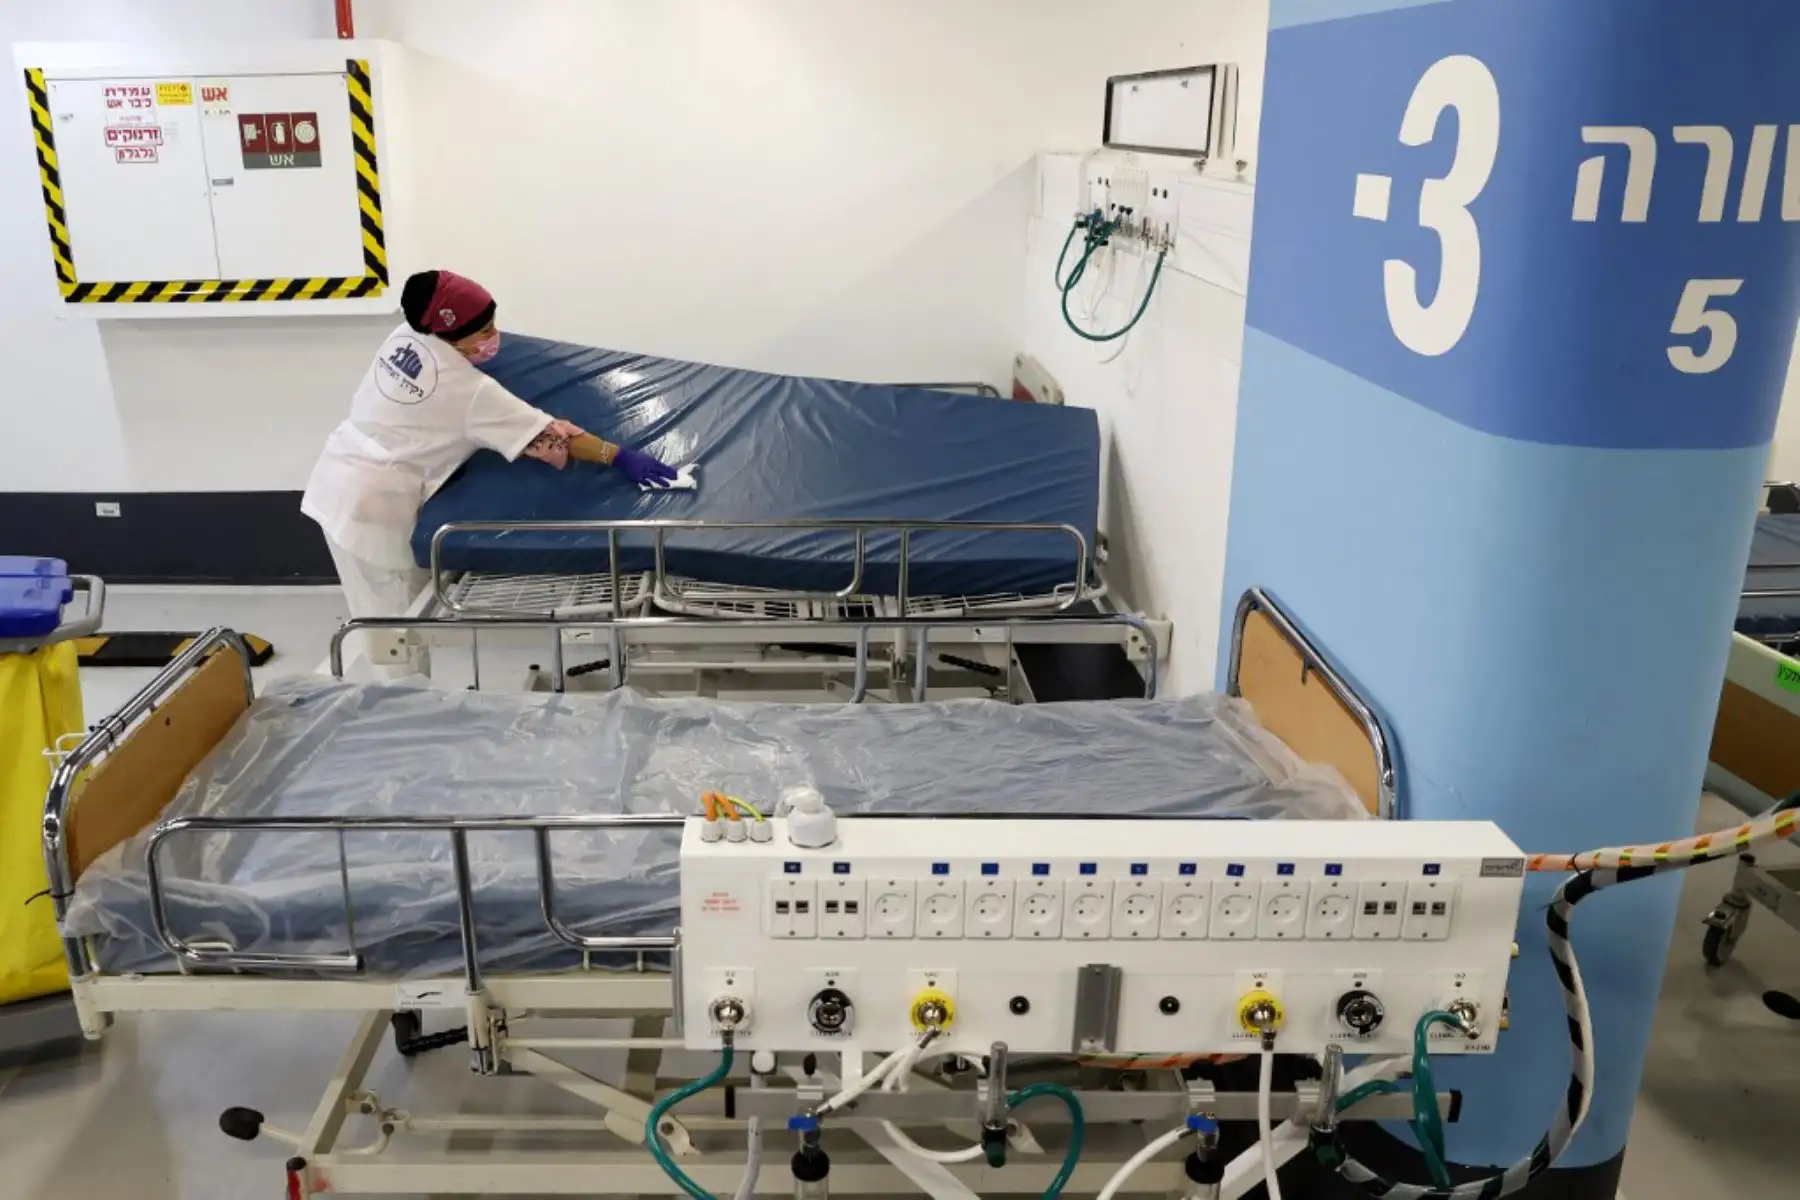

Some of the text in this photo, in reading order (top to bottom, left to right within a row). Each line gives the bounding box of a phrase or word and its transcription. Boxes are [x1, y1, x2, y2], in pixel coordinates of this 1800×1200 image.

[201, 87, 228, 102] אש
[106, 99, 123, 108] אש
[106, 129, 159, 142] זרנוקים
[269, 154, 294, 166] אש
[1353, 54, 1501, 357] -3
[1667, 278, 1744, 375] 5
